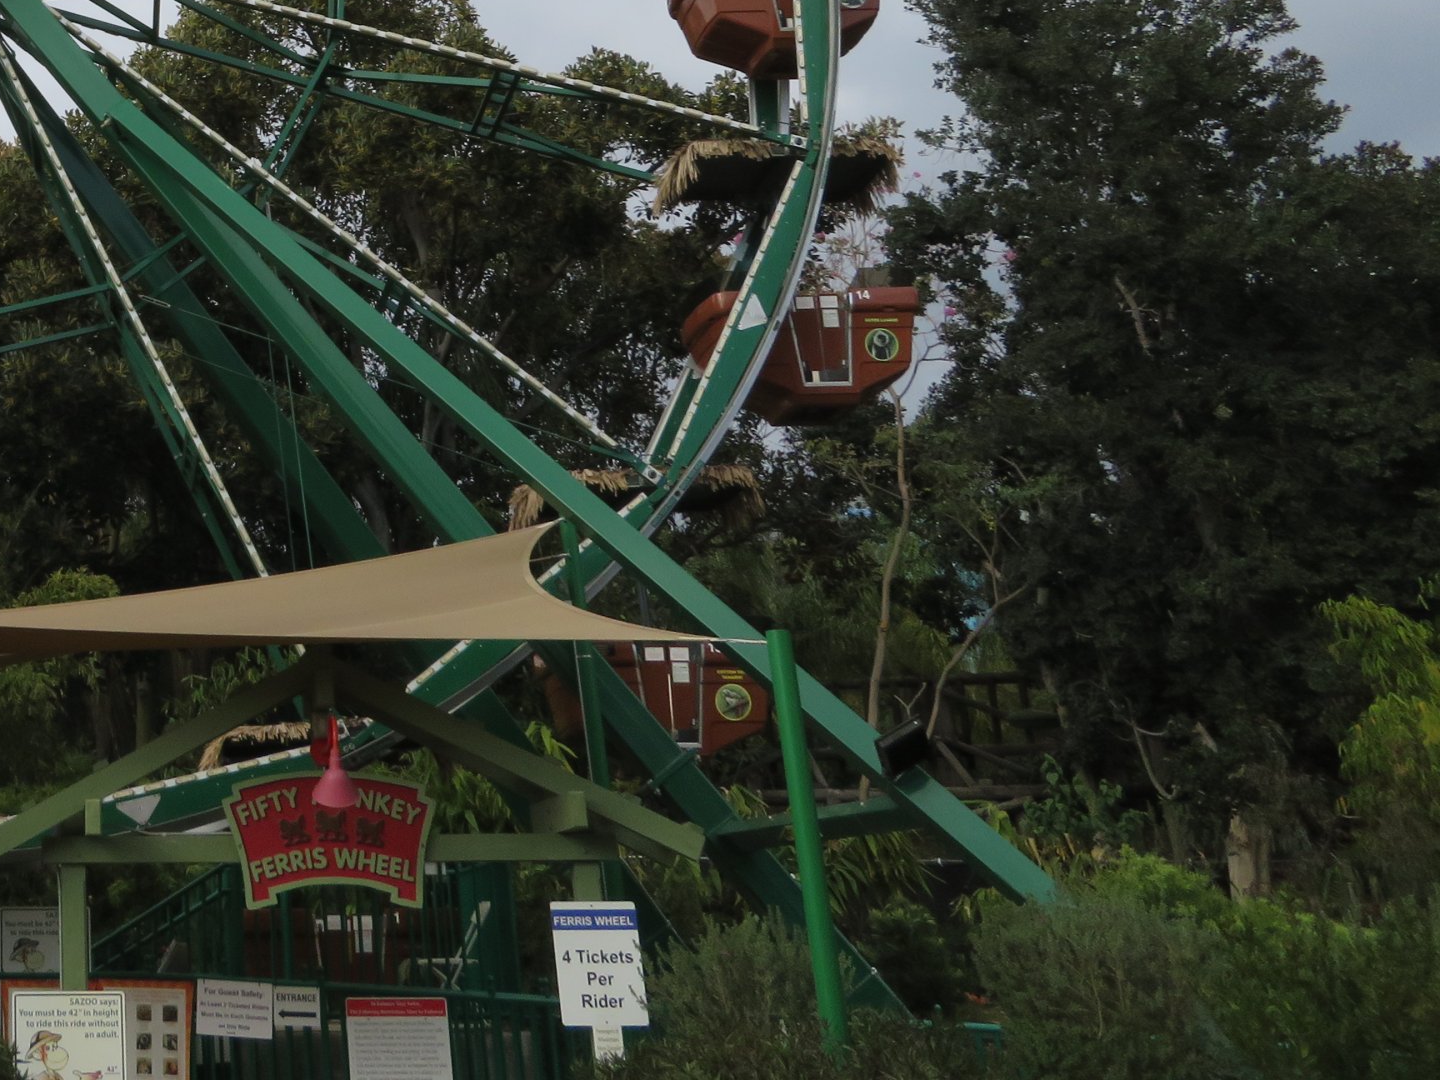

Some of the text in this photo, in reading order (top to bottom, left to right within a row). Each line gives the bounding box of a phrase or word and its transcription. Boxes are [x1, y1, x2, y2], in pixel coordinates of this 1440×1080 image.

[856, 289, 871, 300] 14
[236, 787, 421, 826] FIFTY NKEY
[250, 848, 415, 883] FERRIS WHEEL
[553, 916, 634, 926] FERRIS WHEEL
[562, 949, 634, 964] 4 Tickets
[587, 972, 614, 987] Per
[203, 987, 263, 1000] For Guest Safety
[276, 992, 317, 1003] ENTRANCE
[69, 998, 119, 1009] SAZOO says:
[581, 994, 625, 1009] Rider
[19, 1009, 119, 1019] You must be 42" in height
[26, 1020, 120, 1028] to ride this ride without
[95, 1030, 120, 1039] adult.
